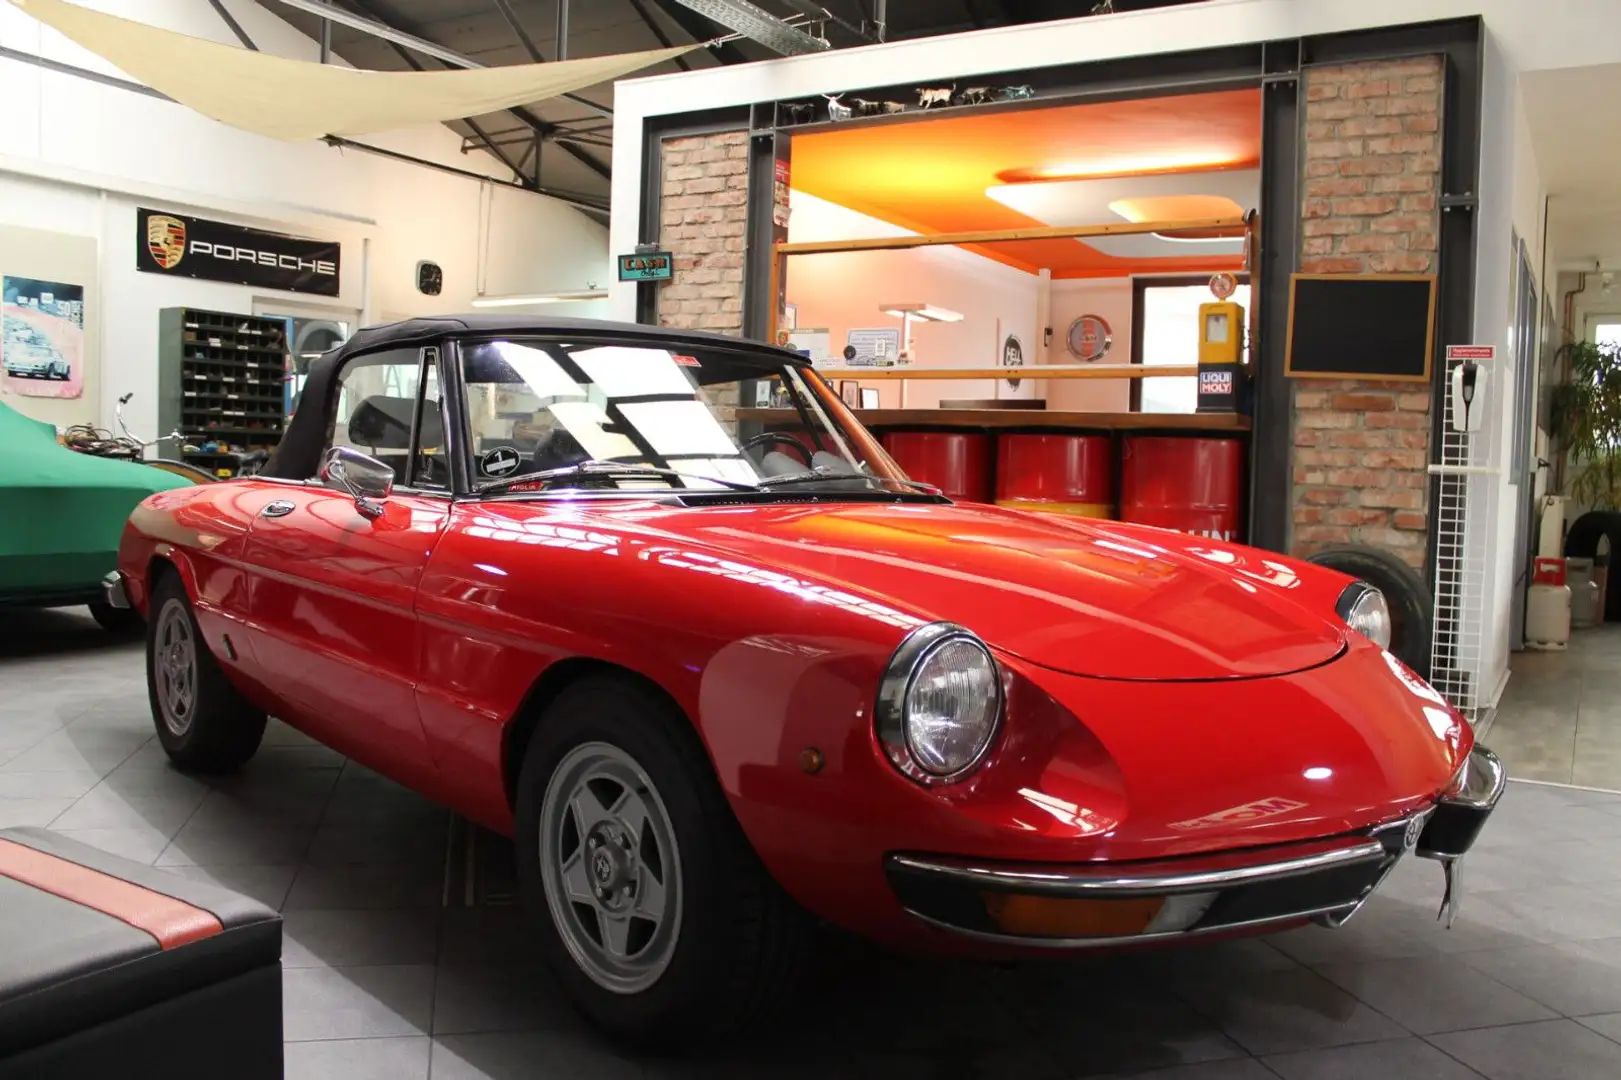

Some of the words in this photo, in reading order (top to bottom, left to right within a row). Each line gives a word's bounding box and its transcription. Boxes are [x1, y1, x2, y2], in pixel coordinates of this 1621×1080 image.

[190, 240, 336, 276] PORSCHE
[624, 257, 667, 270] CASH
[1202, 372, 1231, 382] LIQUI
[1202, 383, 1231, 392] MOLY
